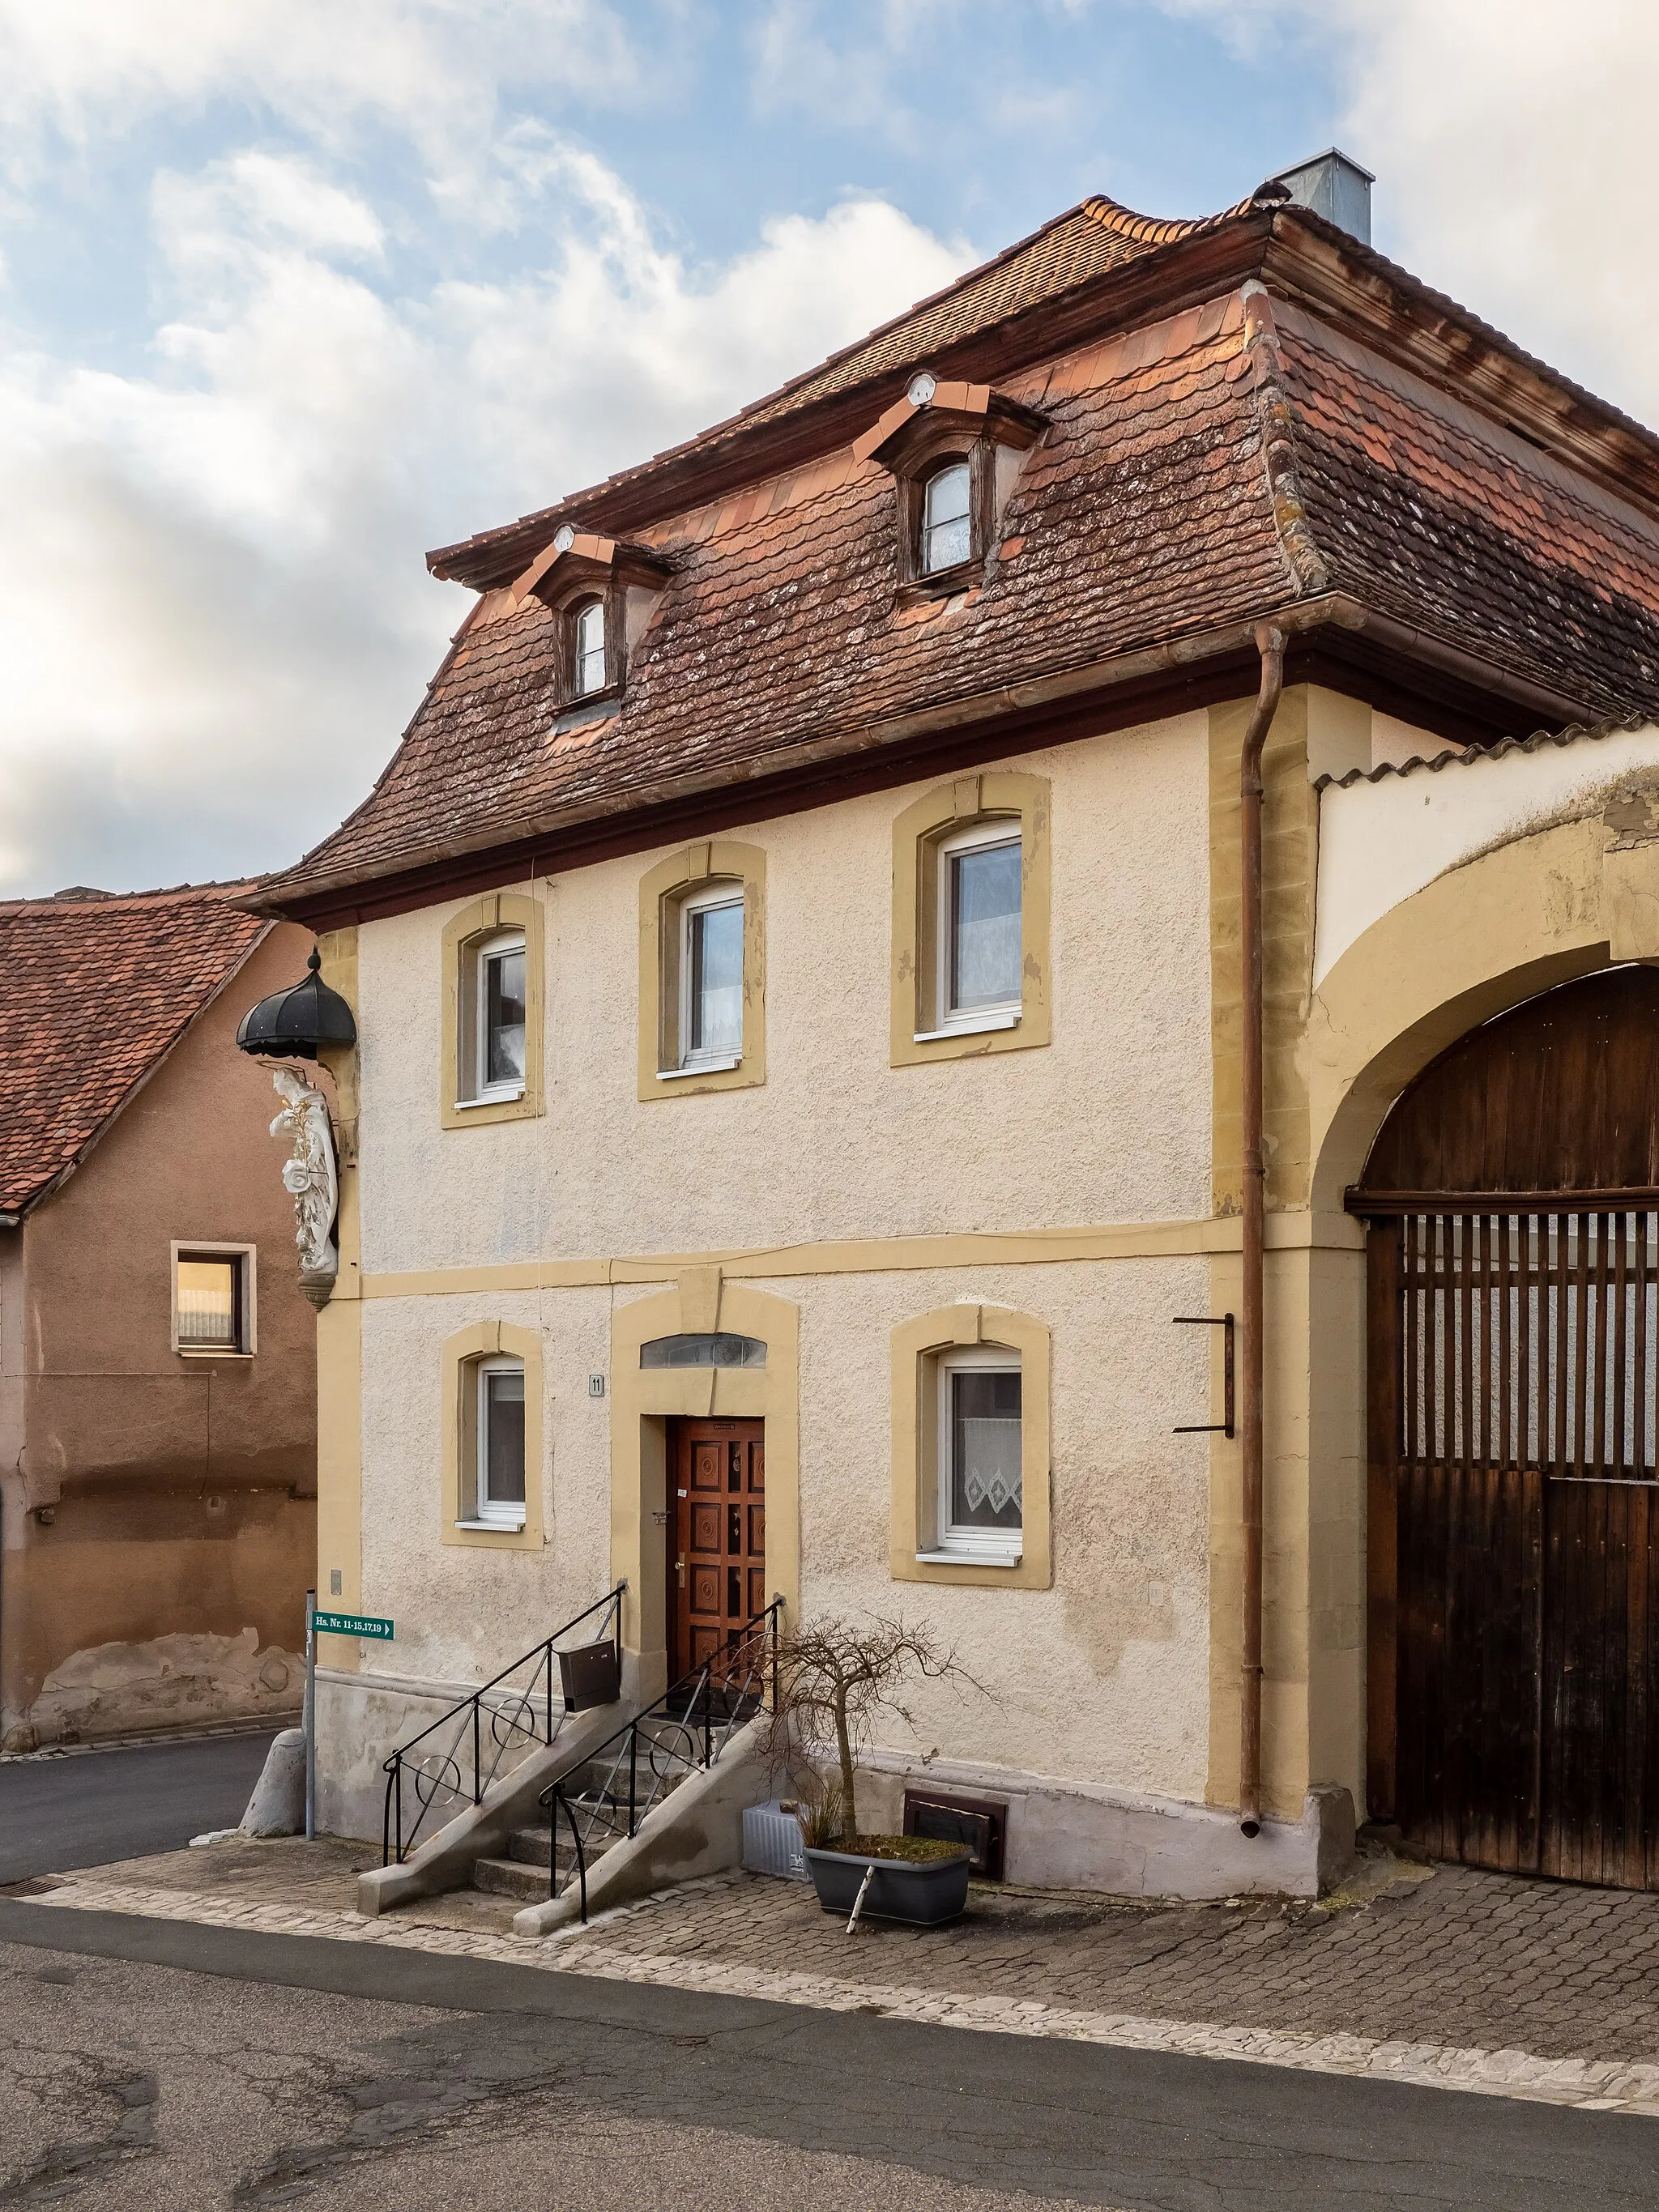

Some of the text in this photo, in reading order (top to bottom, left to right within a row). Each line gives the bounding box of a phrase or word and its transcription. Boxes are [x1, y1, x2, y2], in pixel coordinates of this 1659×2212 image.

[593, 1379, 599, 1391] 11
[316, 1617, 328, 1626] Hs.
[330, 1618, 341, 1627] Nr.
